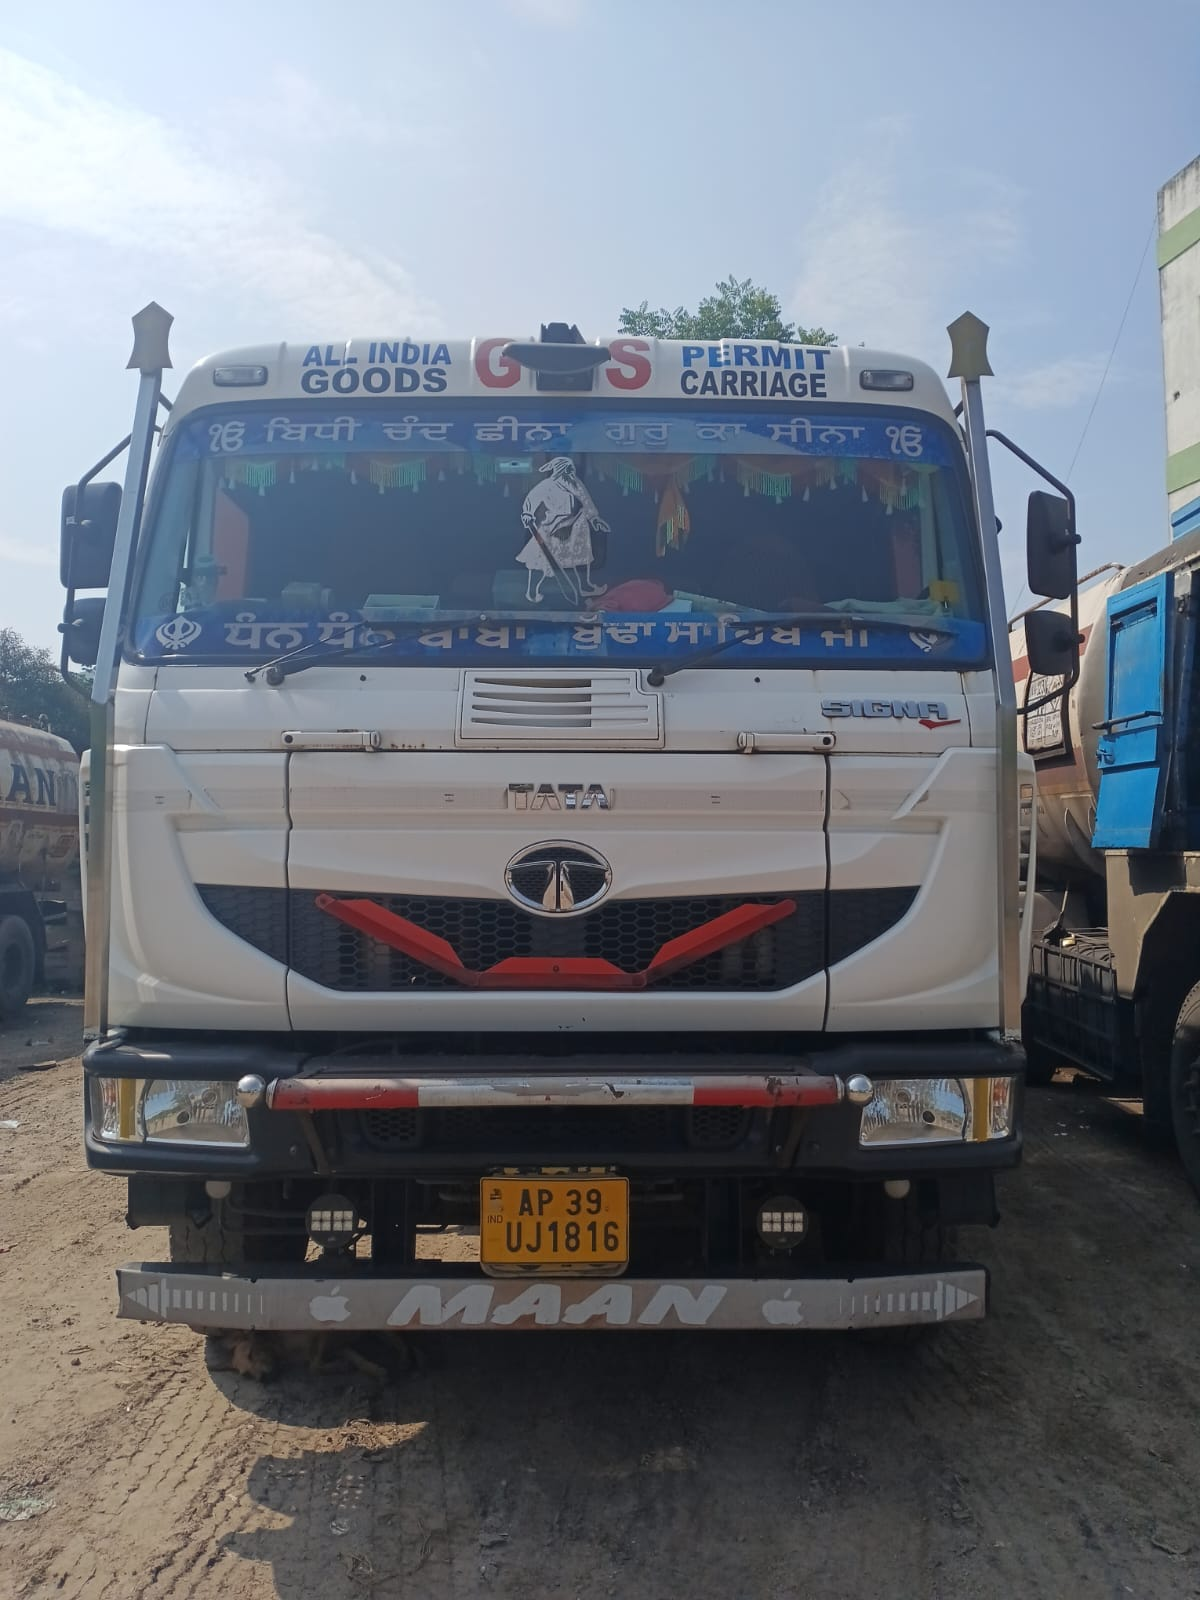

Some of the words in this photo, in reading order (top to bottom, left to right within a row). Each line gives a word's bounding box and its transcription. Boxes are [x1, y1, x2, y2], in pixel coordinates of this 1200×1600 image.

[302, 345, 358, 367] ALL
[367, 342, 452, 366] INDIA
[475, 338, 521, 388] G
[605, 338, 651, 390] S
[681, 344, 830, 370] PERMIT
[300, 367, 448, 394] GOODS
[680, 369, 827, 397] CARRIAGE
[821, 699, 950, 720] SIGNA
[0, 763, 57, 806] AN
[508, 783, 610, 811] TATA
[518, 1188, 554, 1217] AP
[565, 1188, 602, 1216] 39
[487, 1215, 503, 1225] IND
[506, 1220, 619, 1253] UJ1816
[386, 1283, 728, 1326] MAAN
